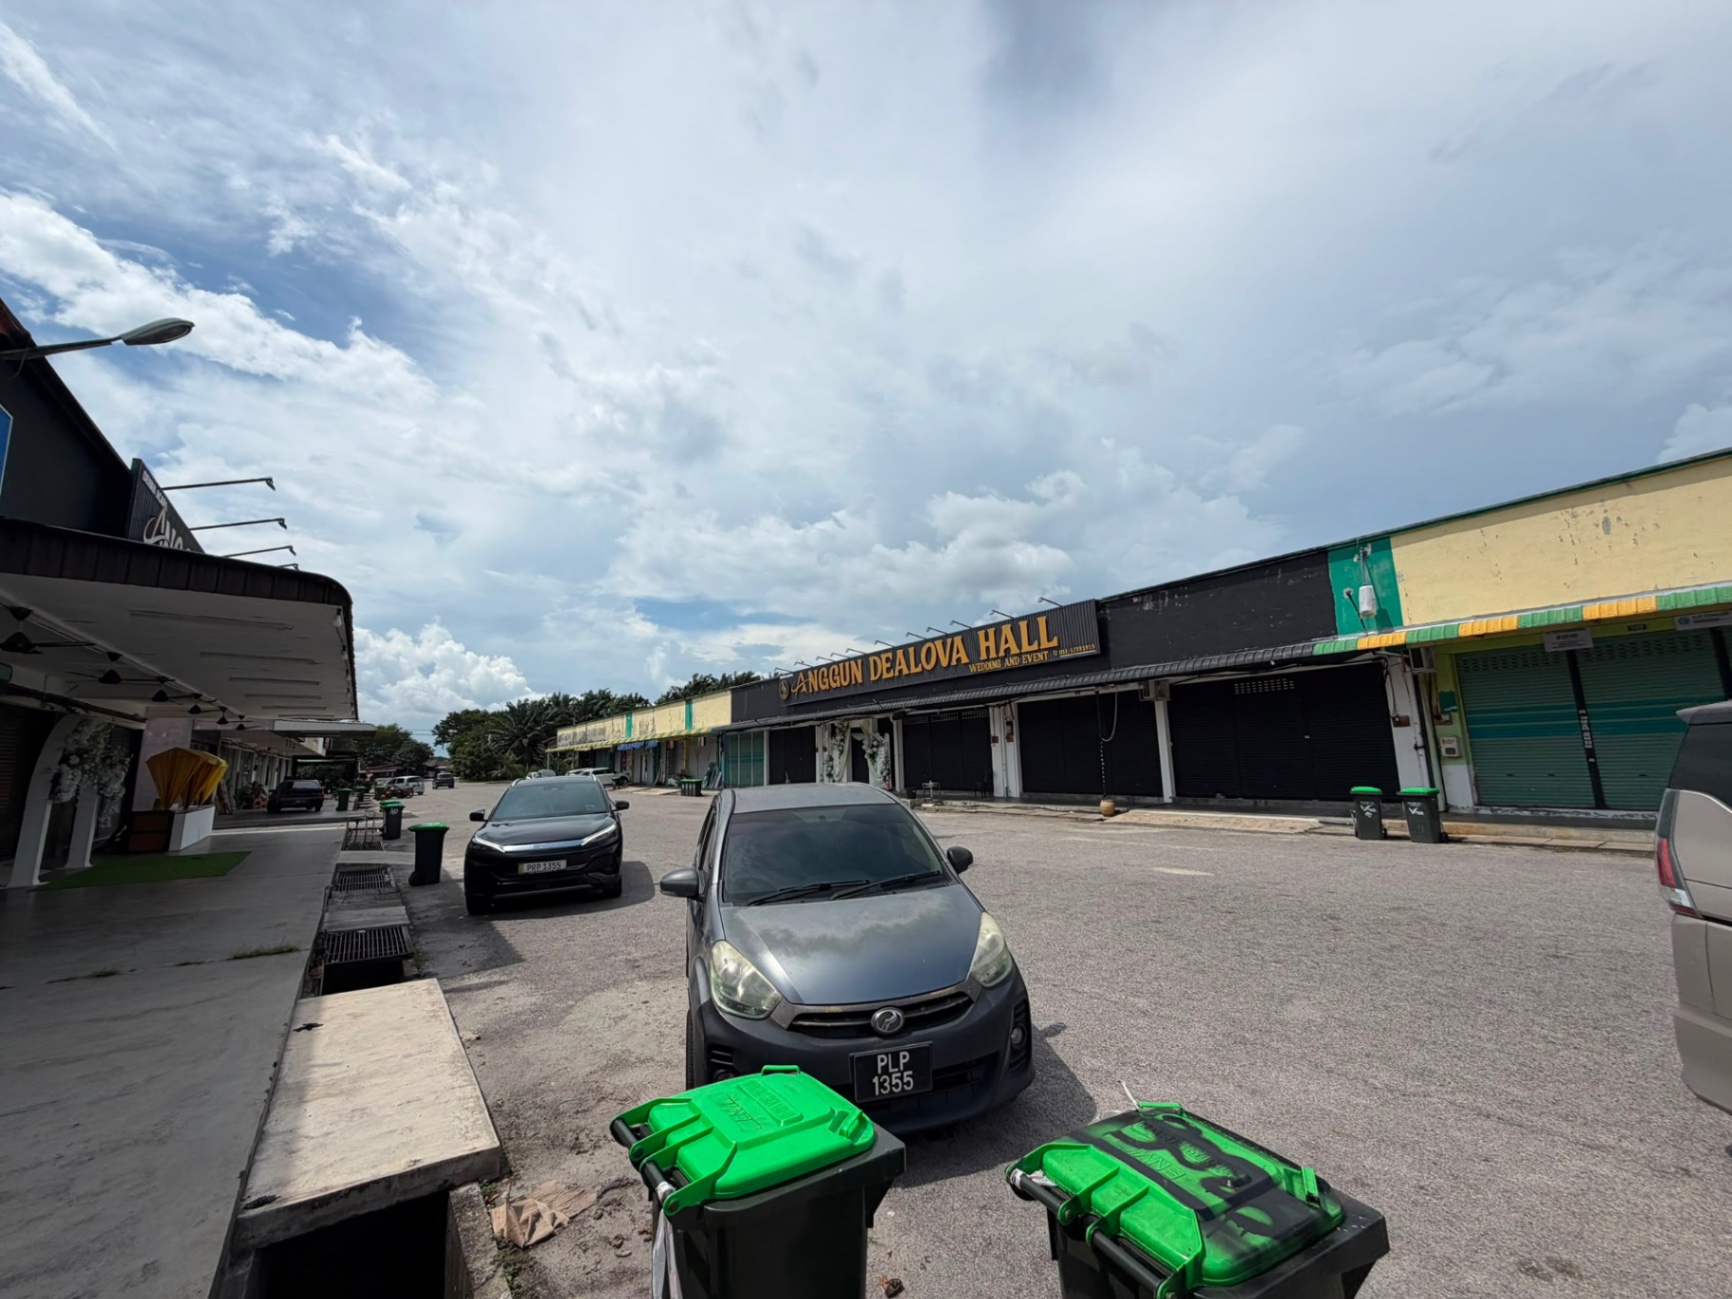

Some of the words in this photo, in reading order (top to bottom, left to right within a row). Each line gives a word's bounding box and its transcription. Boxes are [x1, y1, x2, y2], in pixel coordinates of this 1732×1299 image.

[791, 659, 864, 698] ANGGUN
[869, 635, 970, 681] DEALOVA
[978, 616, 1059, 660] HALL
[969, 660, 1002, 673] WEDDING
[1004, 656, 1021, 667] AND
[1022, 651, 1049, 664] EVENT
[543, 861, 561, 870] 1355
[877, 1051, 910, 1074] PLP
[872, 1070, 914, 1096] 1355
